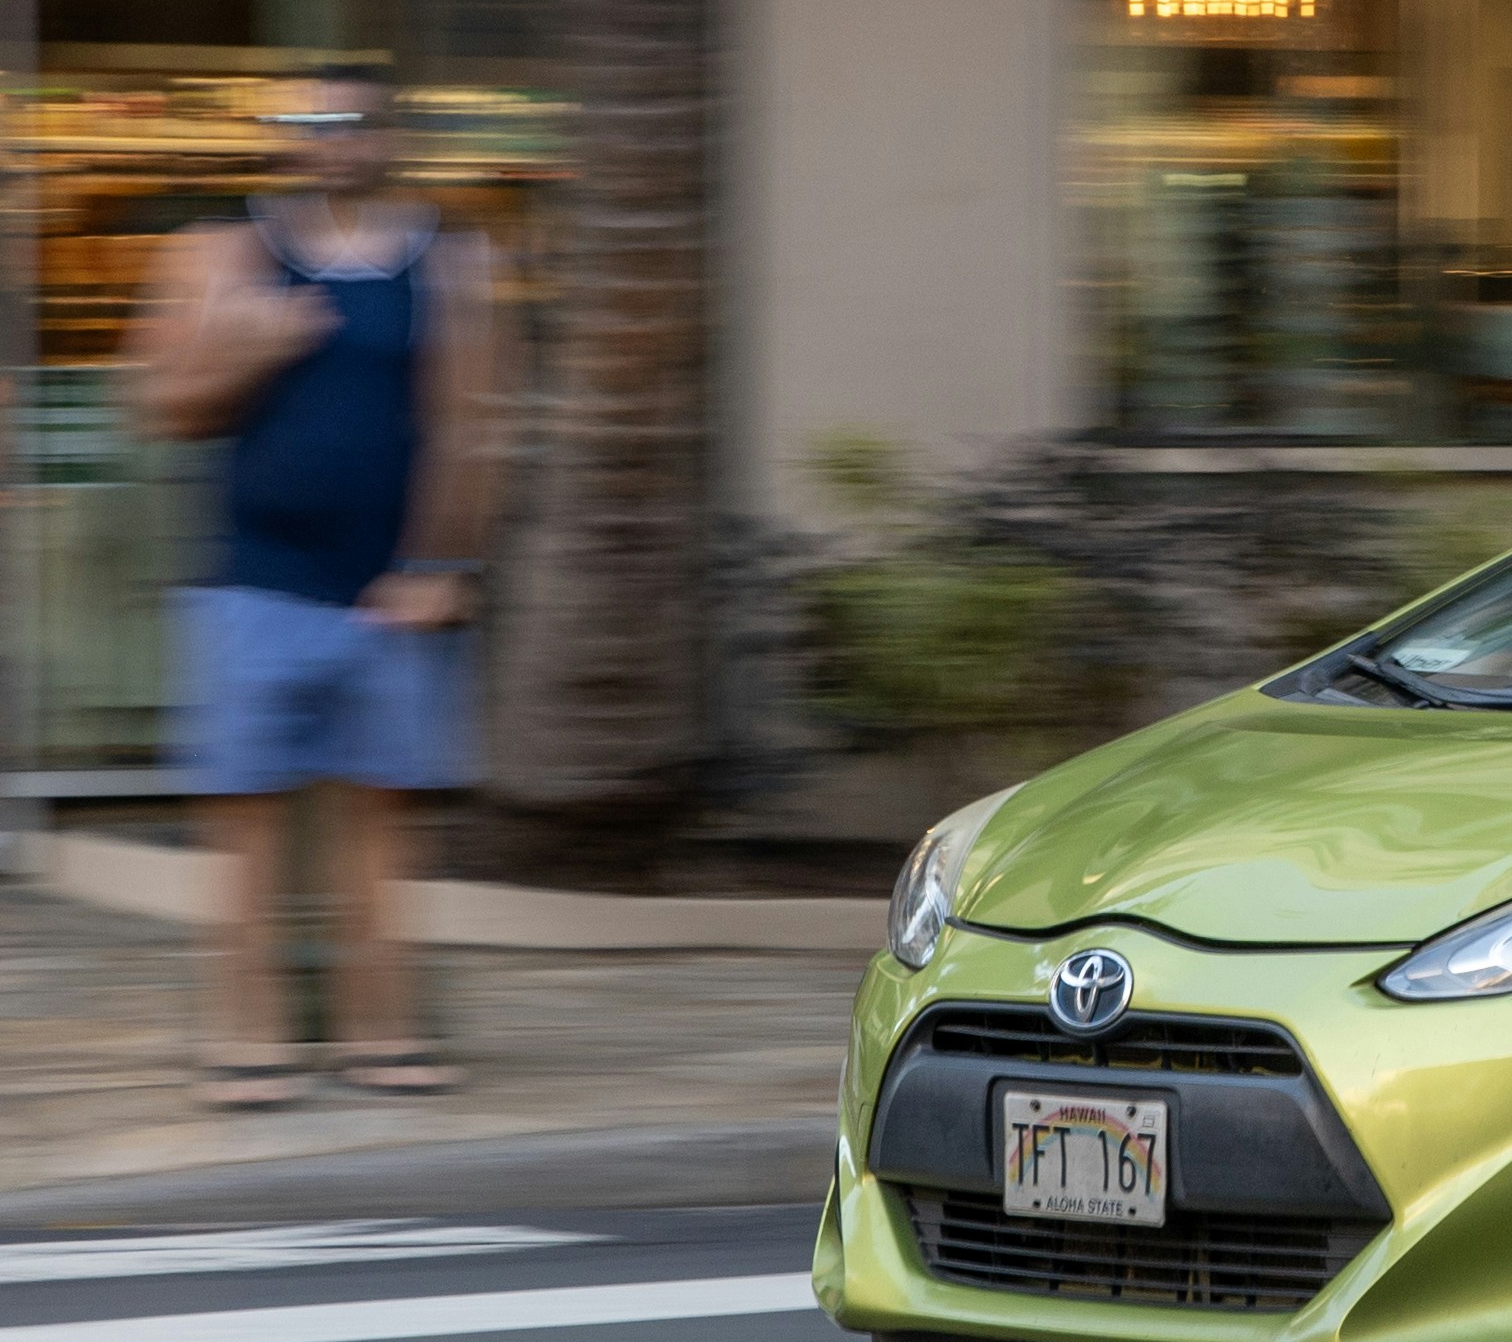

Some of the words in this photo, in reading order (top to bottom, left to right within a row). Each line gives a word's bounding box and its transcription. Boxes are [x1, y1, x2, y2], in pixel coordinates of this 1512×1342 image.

[1059, 1105, 1106, 1124] HAWAII
[1011, 1122, 1071, 1189] TFT
[1097, 1129, 1157, 1196] 167
[1045, 1195, 1085, 1214] ALOHA
[1087, 1198, 1124, 1217] STATE
